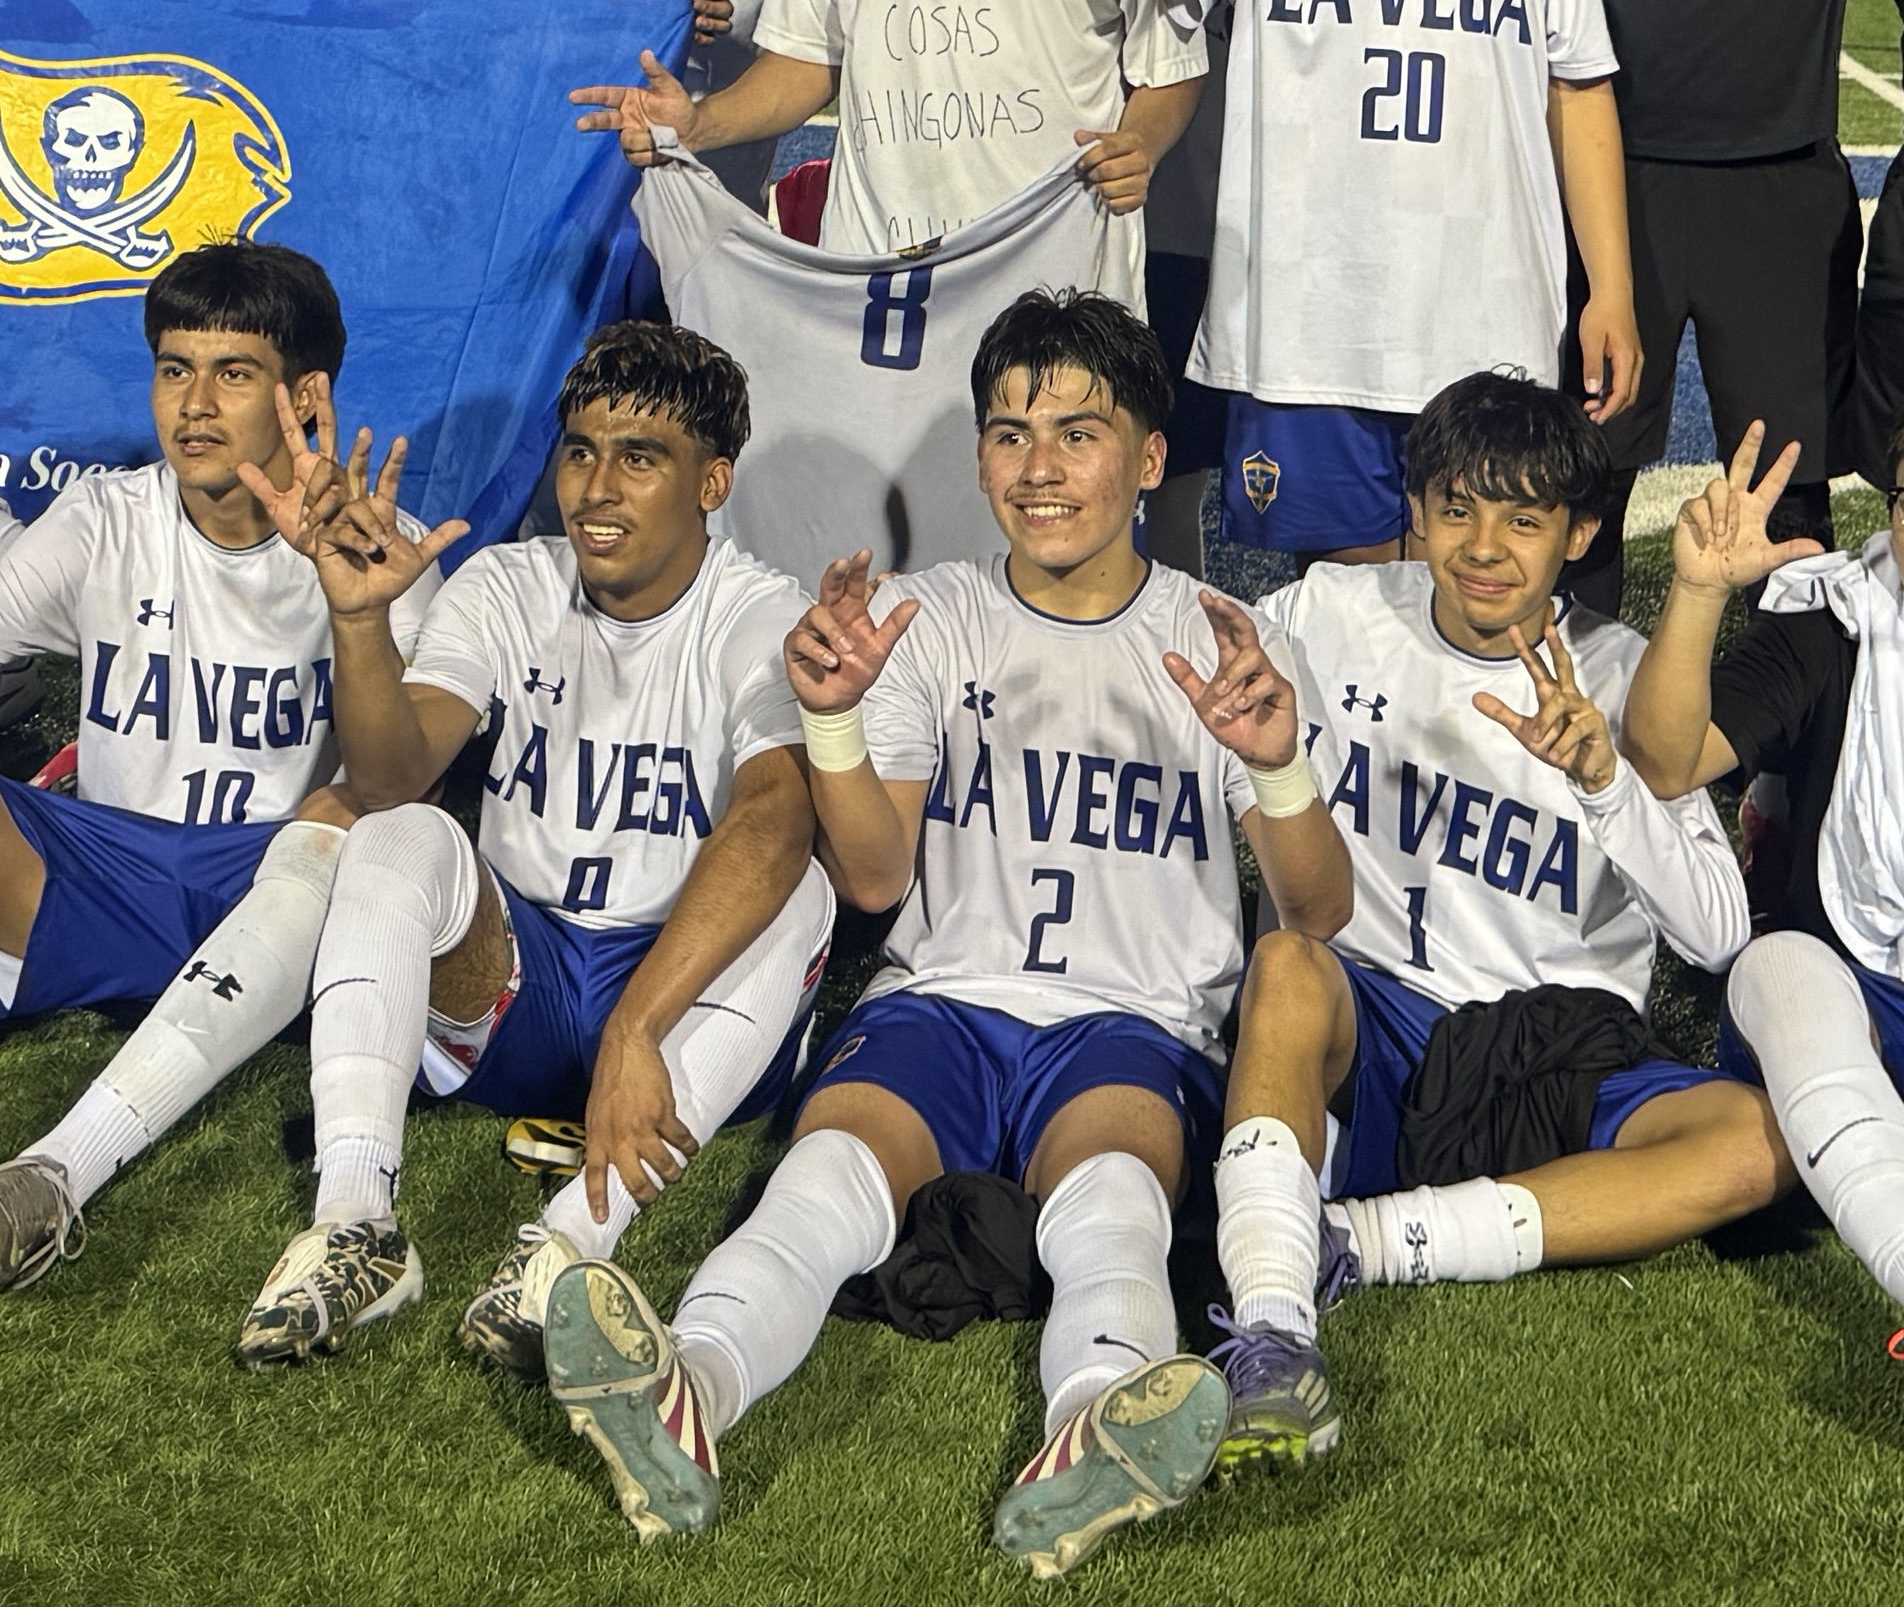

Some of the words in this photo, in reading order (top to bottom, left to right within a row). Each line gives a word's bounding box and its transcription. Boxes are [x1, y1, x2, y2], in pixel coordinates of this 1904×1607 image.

[884, 4, 1000, 61] COSAS
[1361, 47, 1446, 143] 20
[861, 265, 934, 371] 8
[86, 640, 171, 741] LA
[191, 657, 335, 751] VEGA
[576, 738, 713, 840] VEGA
[925, 730, 998, 838] LA
[1023, 749, 1210, 861] VEGA
[1399, 760, 1579, 916] VEGA
[1022, 868, 1075, 975] 2
[1403, 886, 1436, 973] 1
